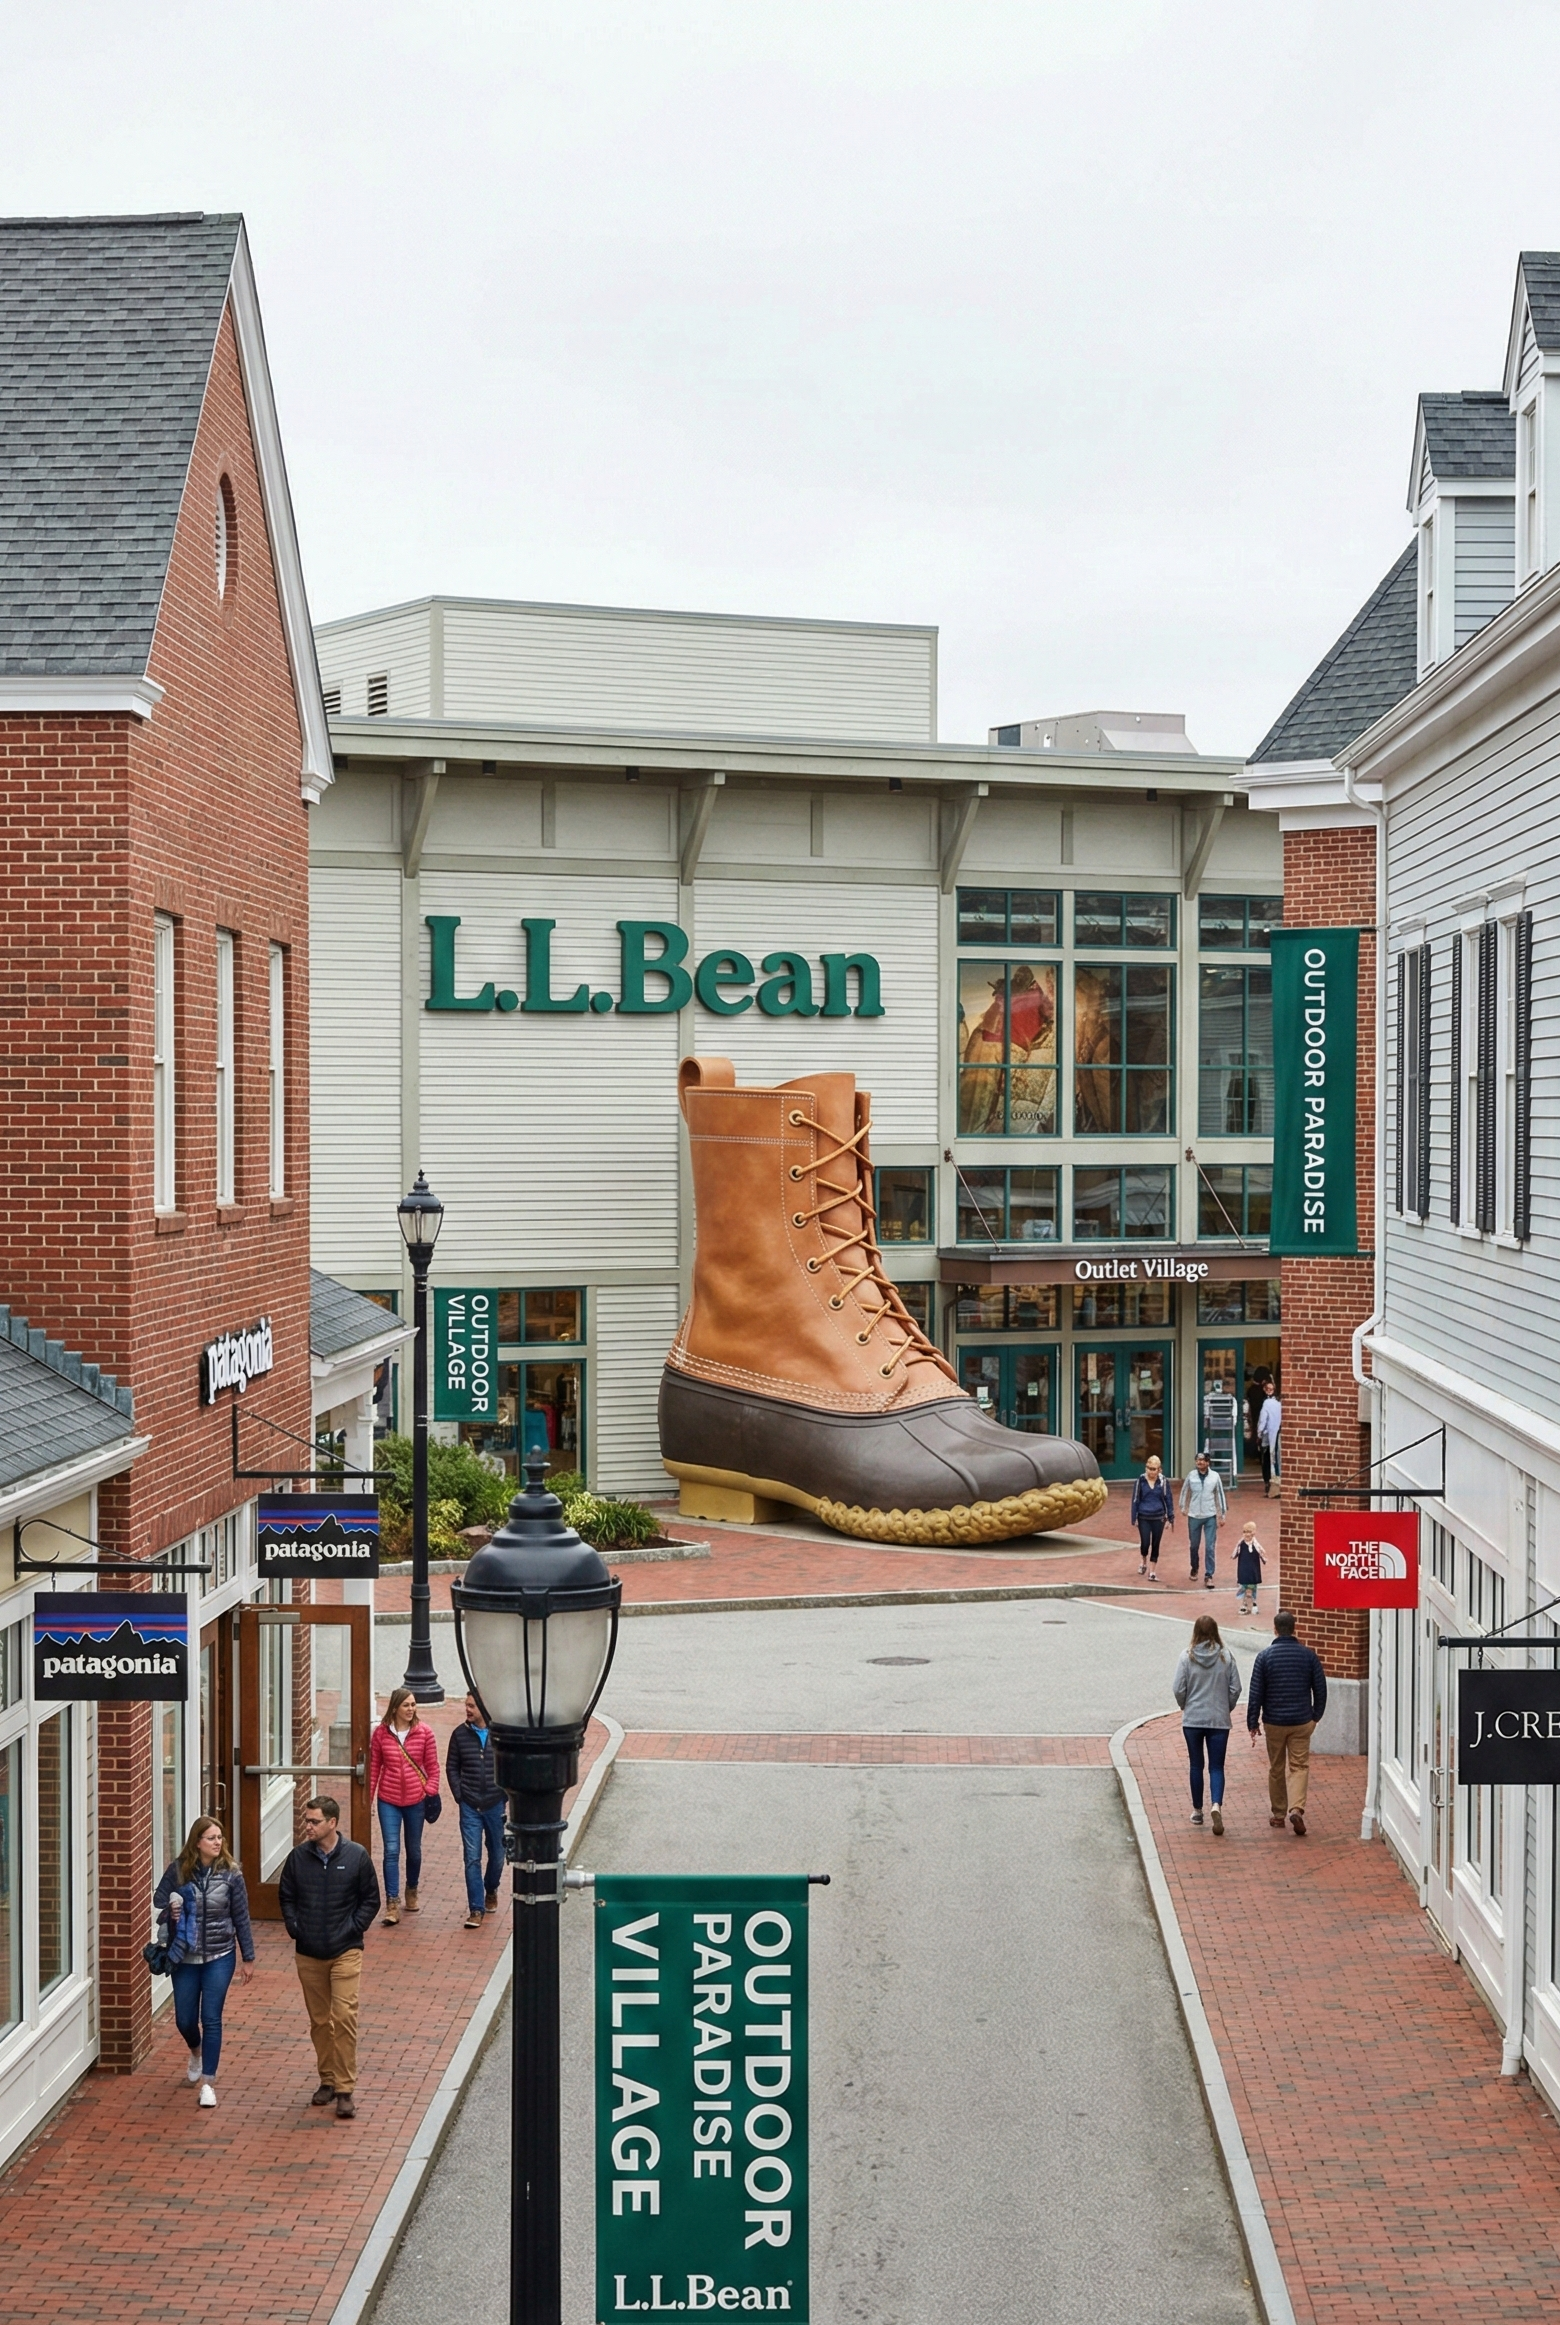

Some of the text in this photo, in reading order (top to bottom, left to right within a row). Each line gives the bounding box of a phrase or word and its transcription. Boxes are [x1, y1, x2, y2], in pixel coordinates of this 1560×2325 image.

[425, 916, 886, 1017] L.L.Bean
[1303, 949, 1326, 1233] OUTDOOR PARADISE
[1075, 1258, 1209, 1282] Outlet Village
[207, 1316, 273, 1404] patagonia
[447, 1294, 466, 1390] VILLAGE
[471, 1294, 490, 1413] OUTDOOR
[265, 1541, 371, 1560] patagonia
[1325, 1554, 1379, 1566] NORTH
[1340, 1567, 1379, 1579] FACE
[1349, 1542, 1379, 1554] THE
[43, 1654, 178, 1678] patagonia
[611, 1912, 660, 2216] VILLAGE
[693, 1914, 732, 2178] PARADISE
[744, 1910, 792, 2250] OUTDOOR
[614, 2275, 792, 2310] L.L.Bean
